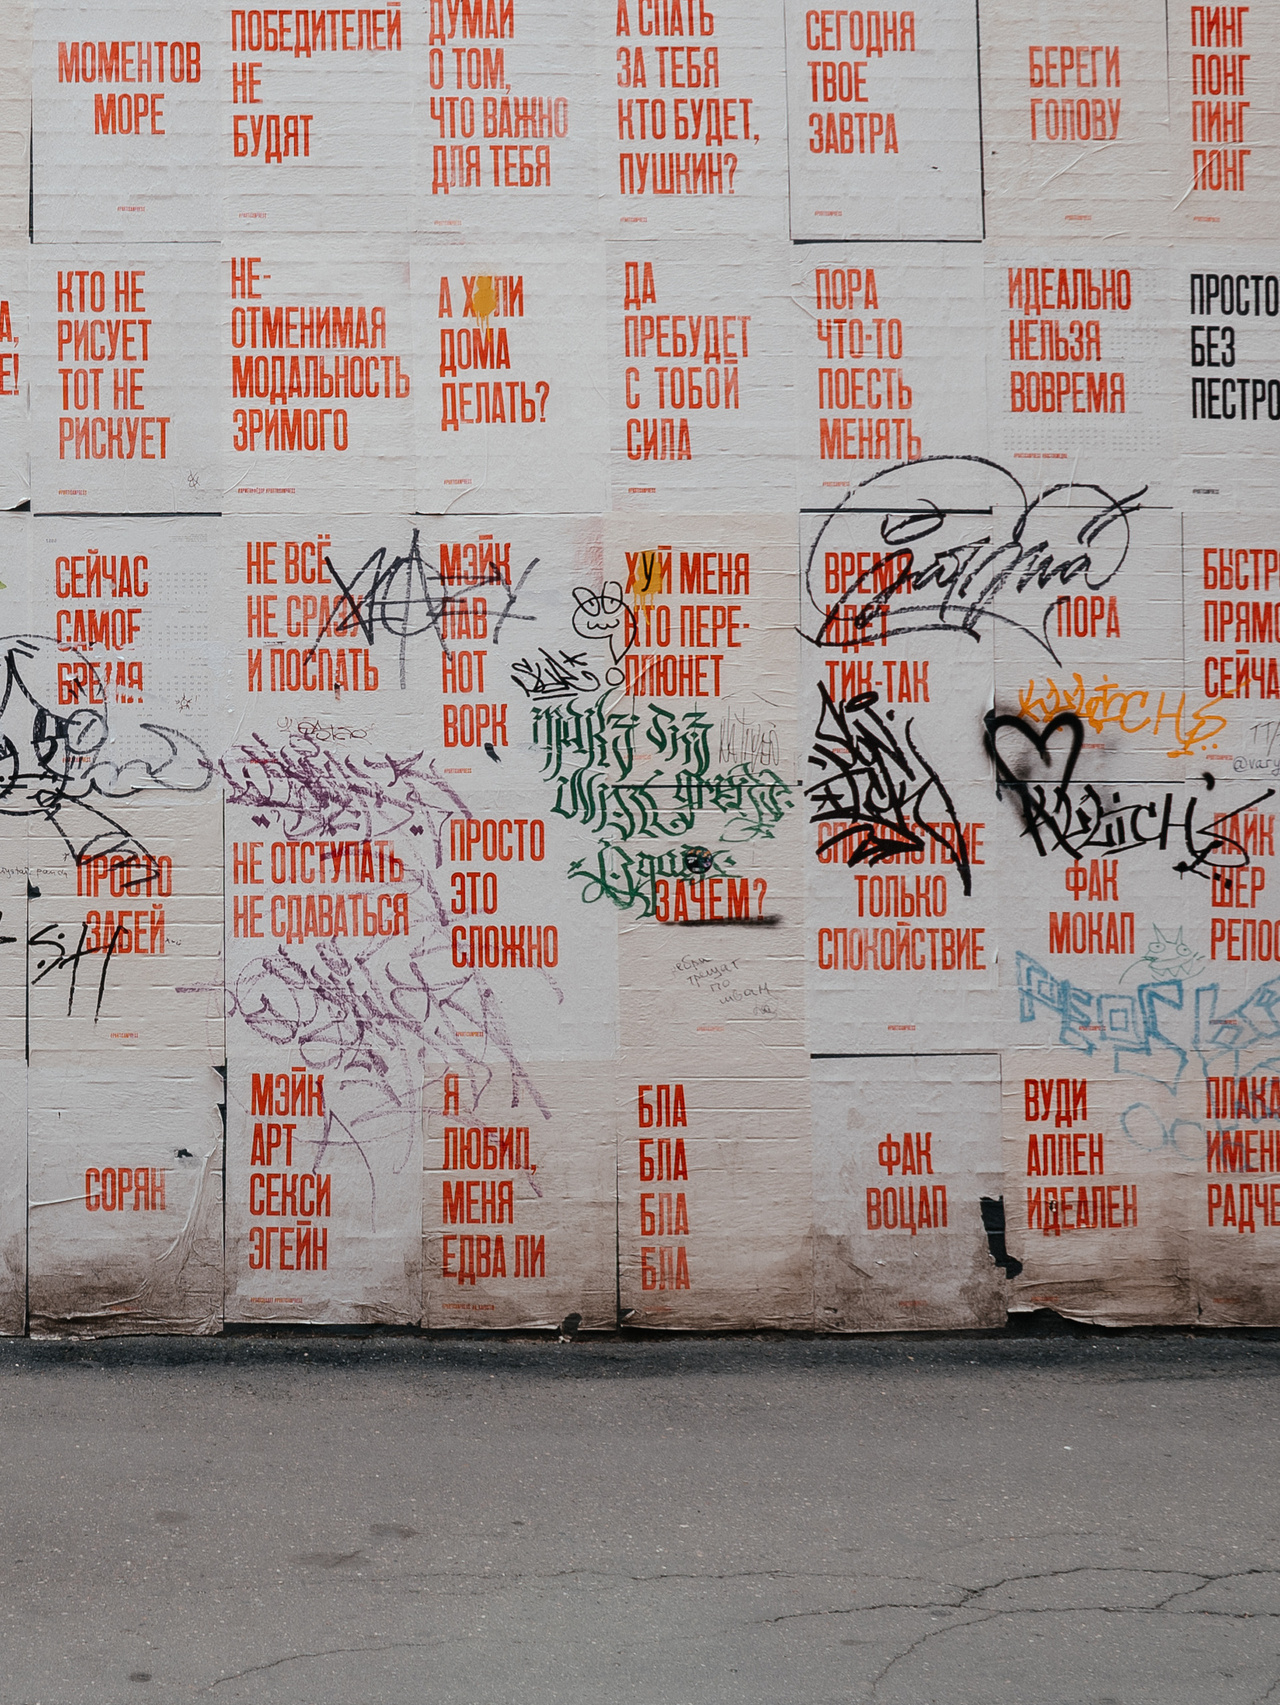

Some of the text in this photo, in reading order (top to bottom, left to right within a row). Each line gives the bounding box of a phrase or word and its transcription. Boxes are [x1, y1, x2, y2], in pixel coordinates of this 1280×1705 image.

[232, 2, 401, 57] ПОБЕДИТЕЛЕЙ
[806, 10, 915, 57] СЕГОДНЯ
[1191, 6, 1249, 47] ПИНГ
[59, 41, 201, 83] МОМЕНТОВ
[233, 62, 262, 103] НЕ
[808, 61, 868, 102] ТВОЕ
[1030, 46, 1120, 87] БЕРЕГИ
[1193, 54, 1251, 95] ПОНГ
[95, 93, 165, 134] МОРЕ
[618, 98, 759, 146] КТО БУДЕТ,
[809, 113, 898, 153] ЗАВТРА
[1031, 99, 1120, 140] ГОЛОВУ
[233, 115, 313, 163] БУДЯТ
[620, 153, 737, 194] ПУШКИН?
[58, 271, 145, 312] КТО НЕ
[624, 262, 656, 310] ДА
[816, 269, 878, 309] ПОРА
[1009, 268, 1131, 315] ИДЕАЛЬНО
[1190, 273, 1280, 316] ПРОСТО
[58, 319, 151, 361] РИСУЕТ
[232, 307, 385, 348] ОТМЕНИМАЯ
[625, 315, 750, 364] ПРЕБУДЕТ
[818, 319, 902, 359] ЧТО-ТО
[1010, 320, 1101, 361] НЕЛЬЗЯ
[1191, 325, 1236, 367] БЕЗ
[440, 327, 511, 377] ДОМА
[59, 368, 144, 410] ТОТ НЕ
[232, 356, 409, 405] МОДАЛЬНОСТЬ
[626, 359, 739, 409] С ТОБОЙ
[819, 368, 912, 409] ПОЕСТЬ
[1011, 371, 1125, 413] ВОВРЕМЯ
[442, 381, 550, 431] ДЕЛАТЬ?
[60, 417, 170, 459] РИСКУЕТ
[233, 409, 348, 451] ЗРИМОГО
[627, 418, 692, 460] СИЛА
[820, 418, 921, 460] МЕНЯТЬ
[56, 549, 148, 598] СЕЙЧАС
[680, 552, 750, 595] МЕНЯ
[625, 605, 750, 648] КТО ПЕРЕ-
[248, 648, 378, 691] И ПОСПАТЬ
[442, 650, 487, 693] НОТ
[625, 654, 724, 696] ПЛЮНЕТ
[444, 704, 508, 747] ВОРК
[451, 818, 545, 861] ПРОСТО
[451, 872, 497, 914] ЭТО
[656, 878, 767, 922] ЗАЧЕМ?
[855, 875, 947, 917] ТОЛЬКО
[1066, 859, 1118, 901] ФАК
[234, 893, 409, 944] НЕ СДАВАТЬСЯ
[1050, 912, 1134, 954] МОКАП
[452, 926, 558, 968] СЛОЖНО
[819, 921, 986, 970] СПОКОЙСТВИЕ
[252, 1067, 324, 1116] МЭЙК
[443, 1074, 459, 1115] Я
[638, 1084, 687, 1128] БЛА
[1024, 1078, 1087, 1128] ВУДИ
[251, 1123, 297, 1166] АРТ
[443, 1127, 536, 1175] ЛЮБИЛ,
[639, 1138, 688, 1182] БЛА
[878, 1132, 934, 1176] ФАК
[1027, 1133, 1104, 1176] АЛЛЕН
[86, 1168, 164, 1211] СОРЯН
[250, 1173, 331, 1217] СЕКСИ
[443, 1181, 513, 1224] МЕНЯ
[867, 1185, 947, 1235] ВОЦАП
[1027, 1185, 1137, 1236] ИДЕАЛЕН
[249, 1221, 327, 1270] ЭГЕЙН
[443, 1235, 545, 1285] ЕДВА ЛИ
